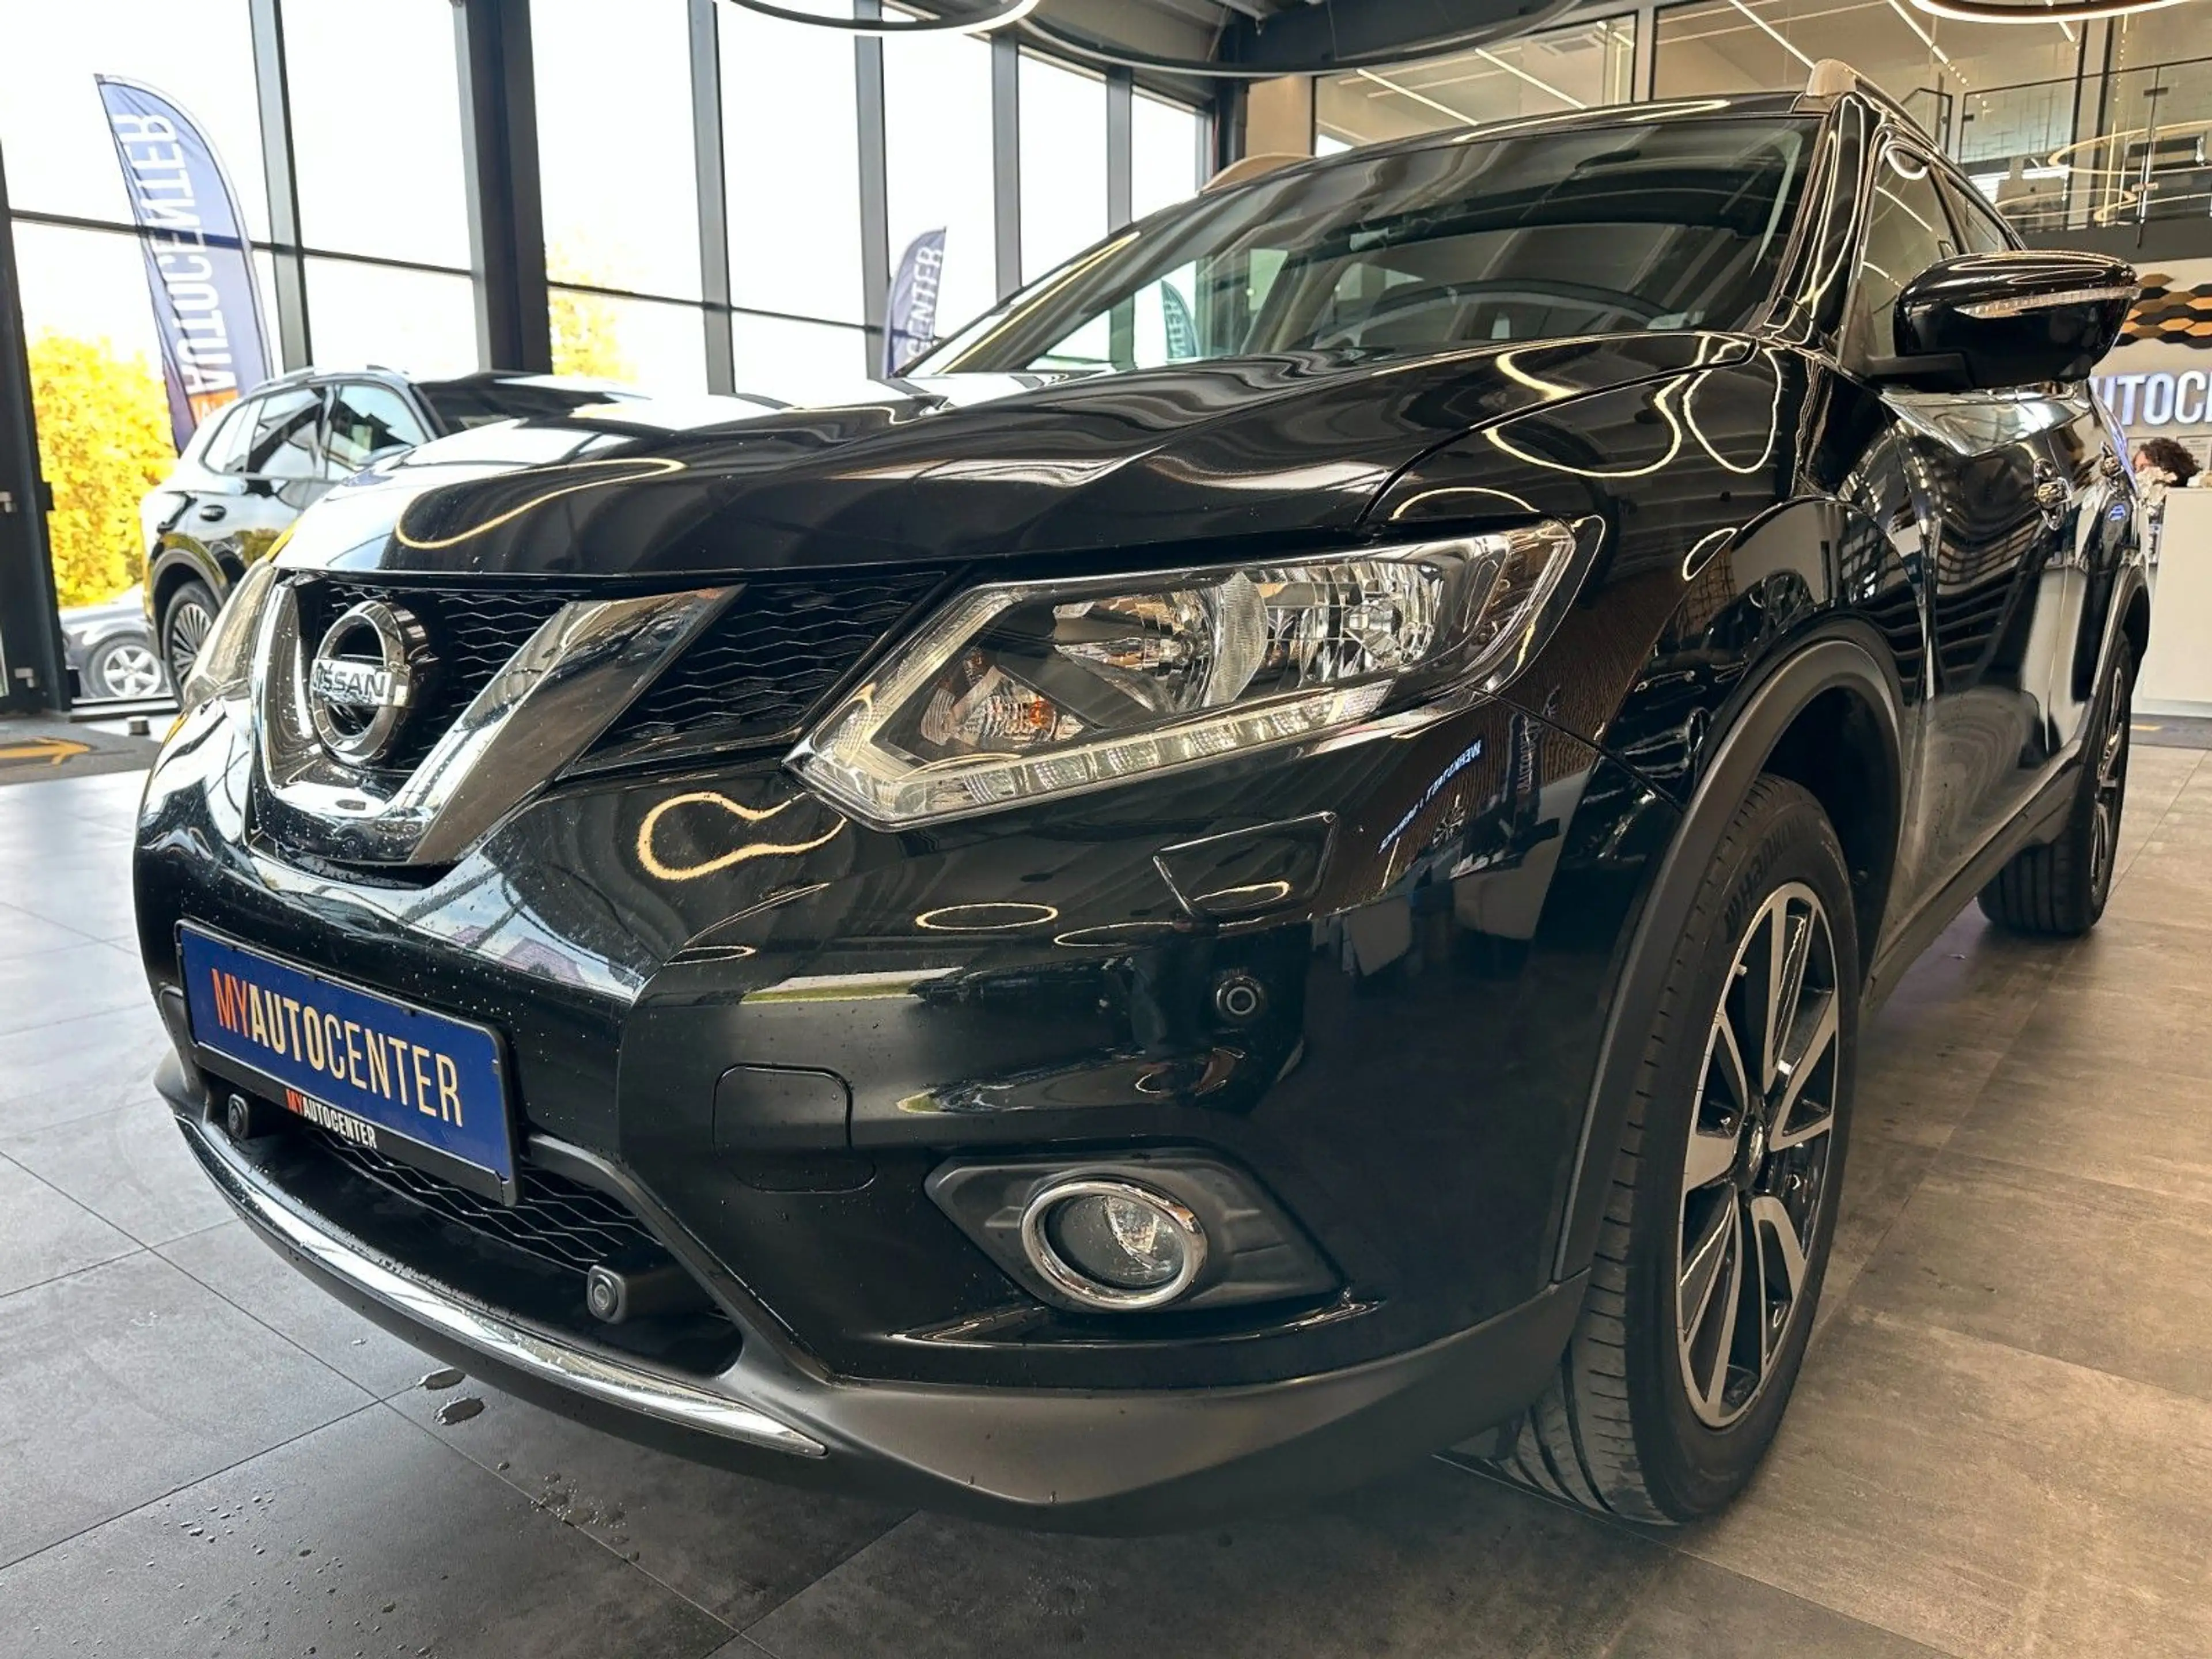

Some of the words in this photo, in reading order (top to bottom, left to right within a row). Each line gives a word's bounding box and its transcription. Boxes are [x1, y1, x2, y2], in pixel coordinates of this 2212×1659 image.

[313, 662, 385, 698] NISSAN
[211, 968, 463, 1127] MYAUTOCENTER
[286, 1088, 378, 1149] MYAUTOCENTER
